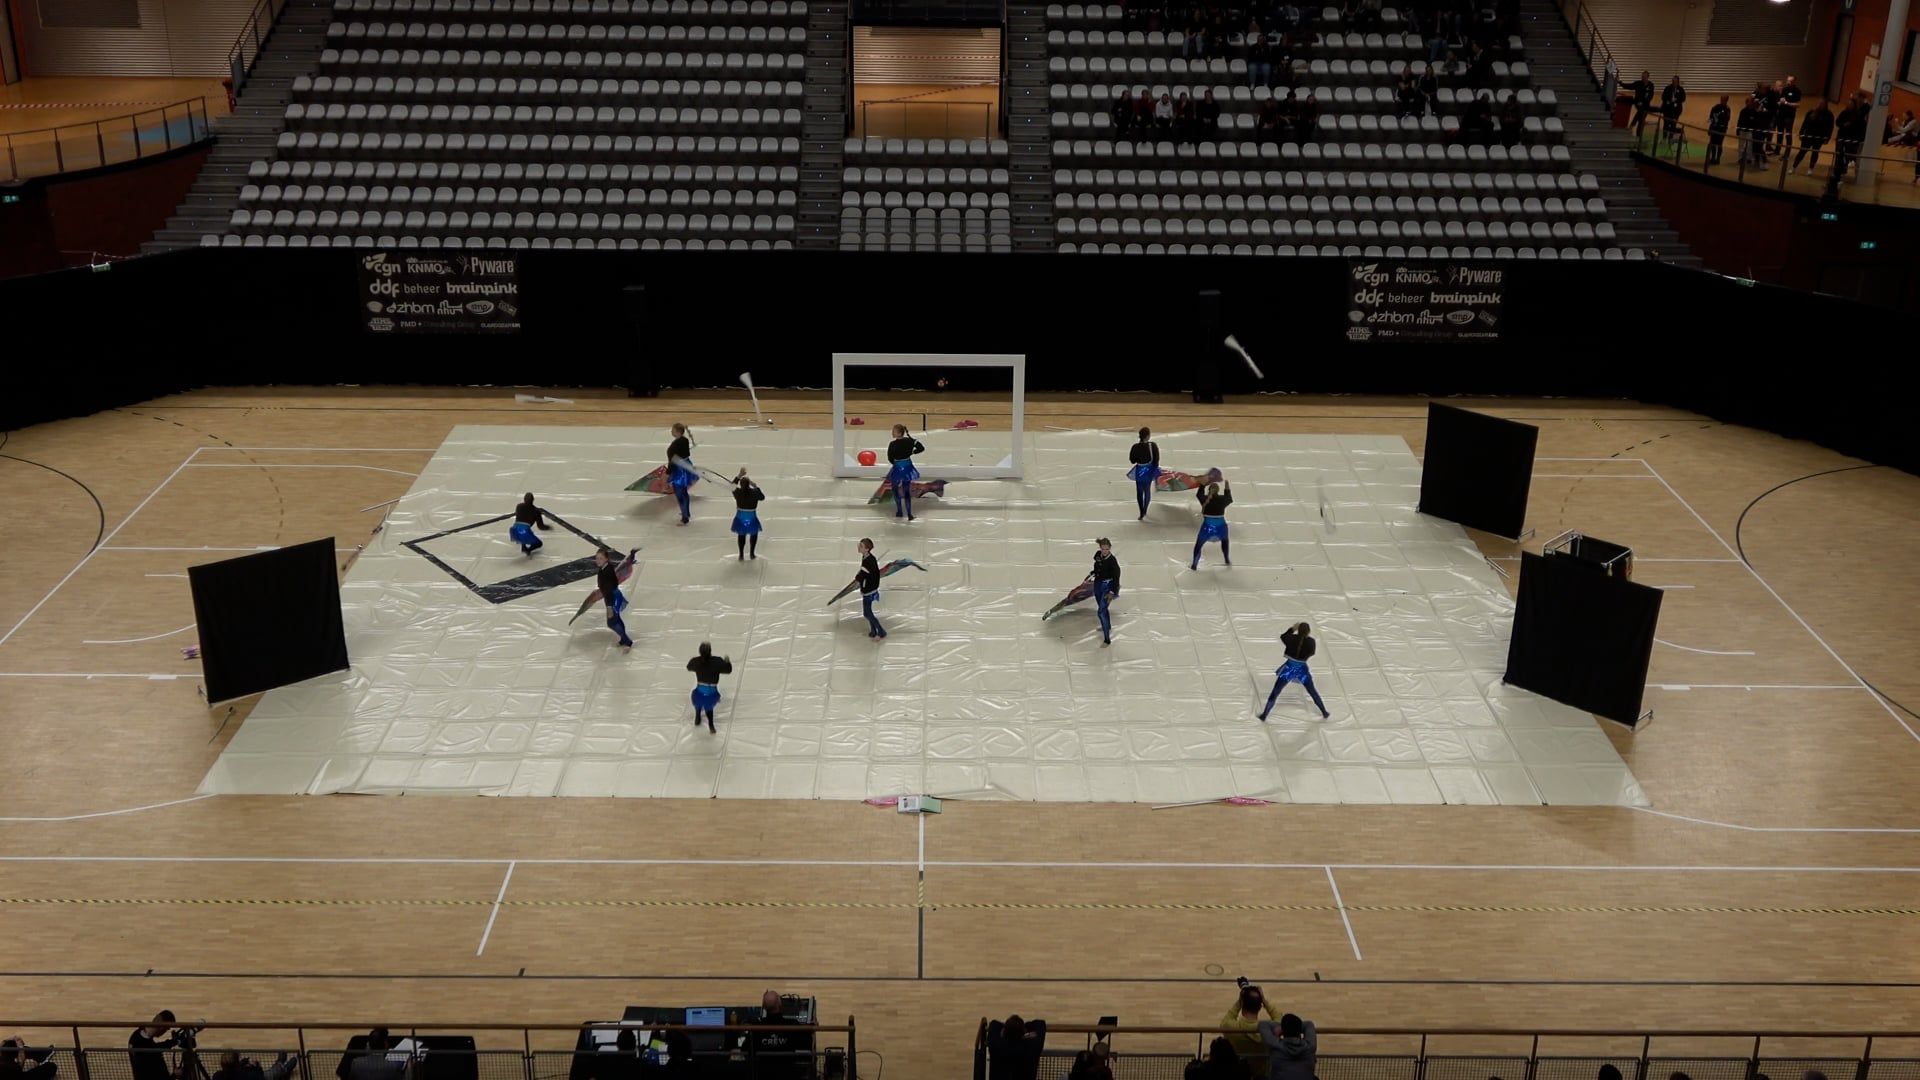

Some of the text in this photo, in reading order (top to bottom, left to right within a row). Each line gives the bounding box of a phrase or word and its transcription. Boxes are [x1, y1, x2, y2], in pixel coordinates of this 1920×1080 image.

[374, 262, 401, 277] cgn
[408, 263, 442, 273] KNMO
[471, 257, 514, 276] Pyware
[1363, 272, 1389, 287] cgn
[1396, 273, 1431, 283] KNMO
[1460, 267, 1502, 286] Pyware
[369, 279, 440, 298] ddf beheer
[447, 282, 518, 296] brainpink
[1354, 289, 1424, 307] ddf beheer
[1430, 292, 1501, 306] brainpink
